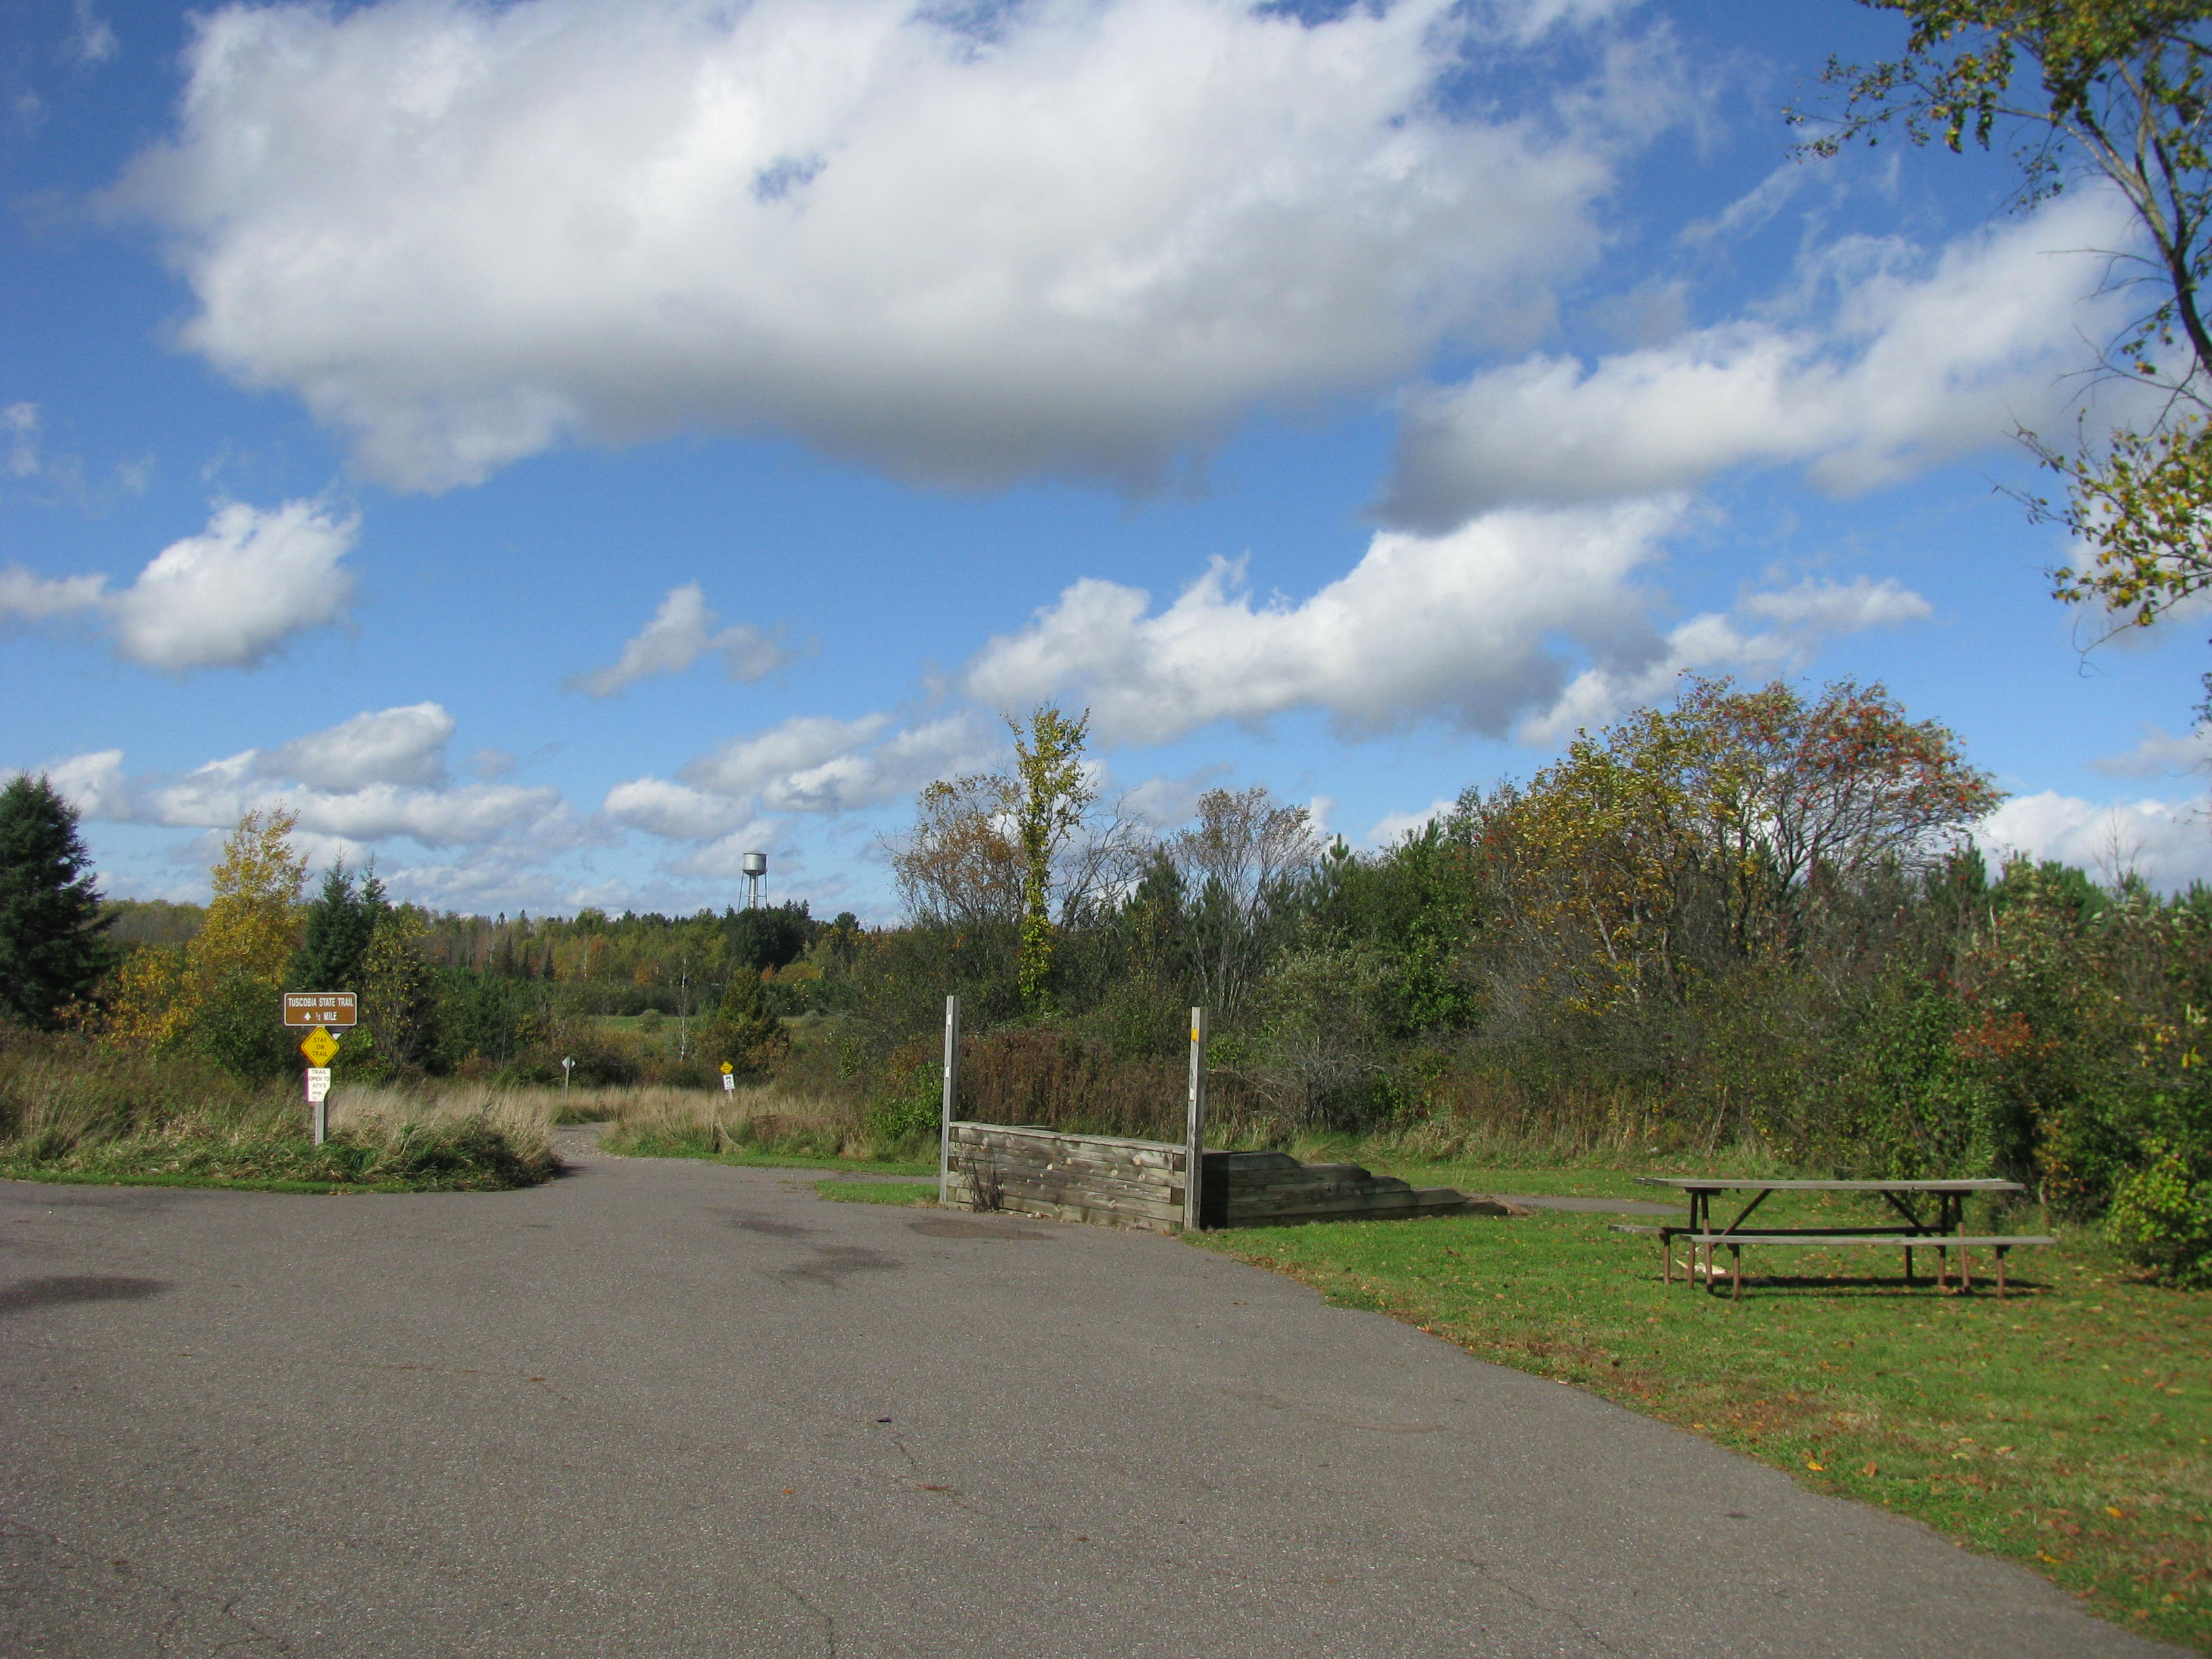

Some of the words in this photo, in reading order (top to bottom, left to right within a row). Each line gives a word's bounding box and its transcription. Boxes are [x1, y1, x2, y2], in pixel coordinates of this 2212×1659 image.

[288, 998, 316, 1006] TUSCOBIA
[319, 998, 335, 1006] STATE
[337, 998, 354, 1006] TRAIL
[323, 1011, 337, 1021] MILE
